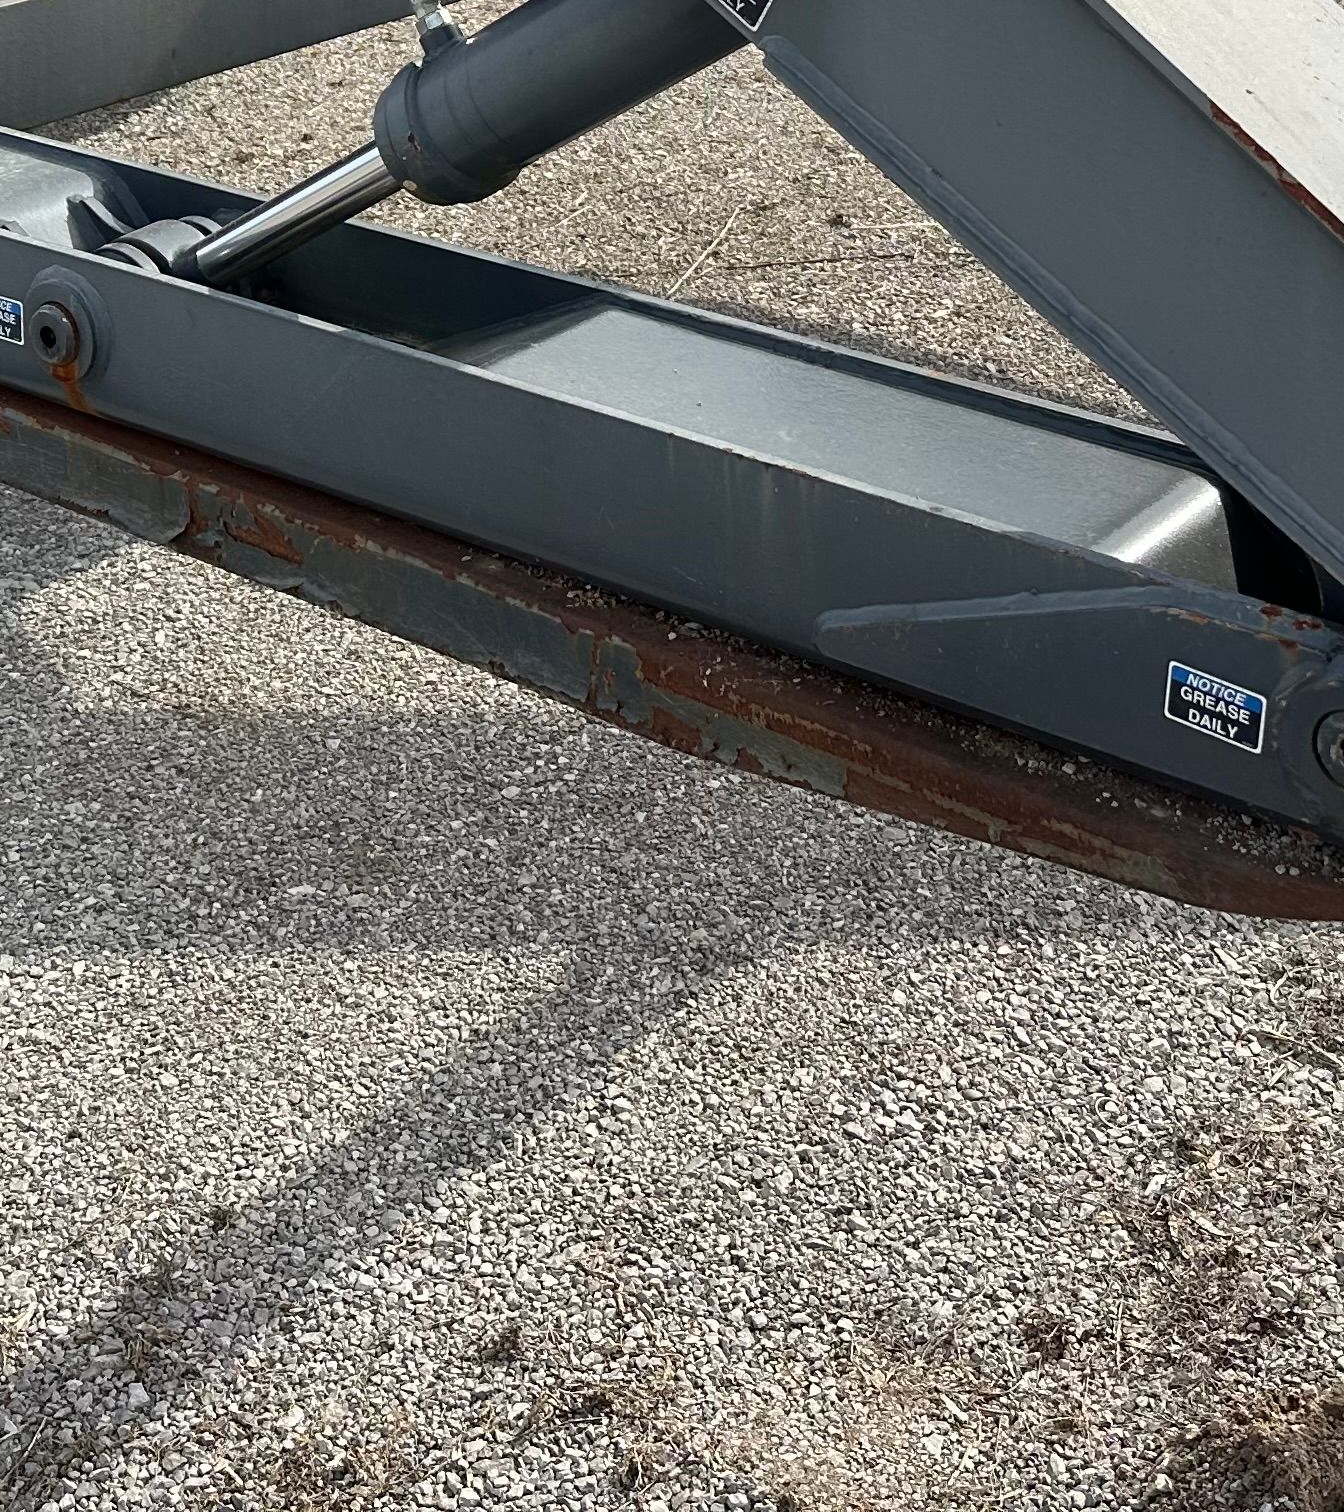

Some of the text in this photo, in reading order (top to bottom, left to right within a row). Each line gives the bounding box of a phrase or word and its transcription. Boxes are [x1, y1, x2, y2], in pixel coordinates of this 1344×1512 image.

[1180, 686, 1251, 724] GREASE
[1186, 673, 1246, 706] NOTICE
[1188, 708, 1238, 738] DAILY
